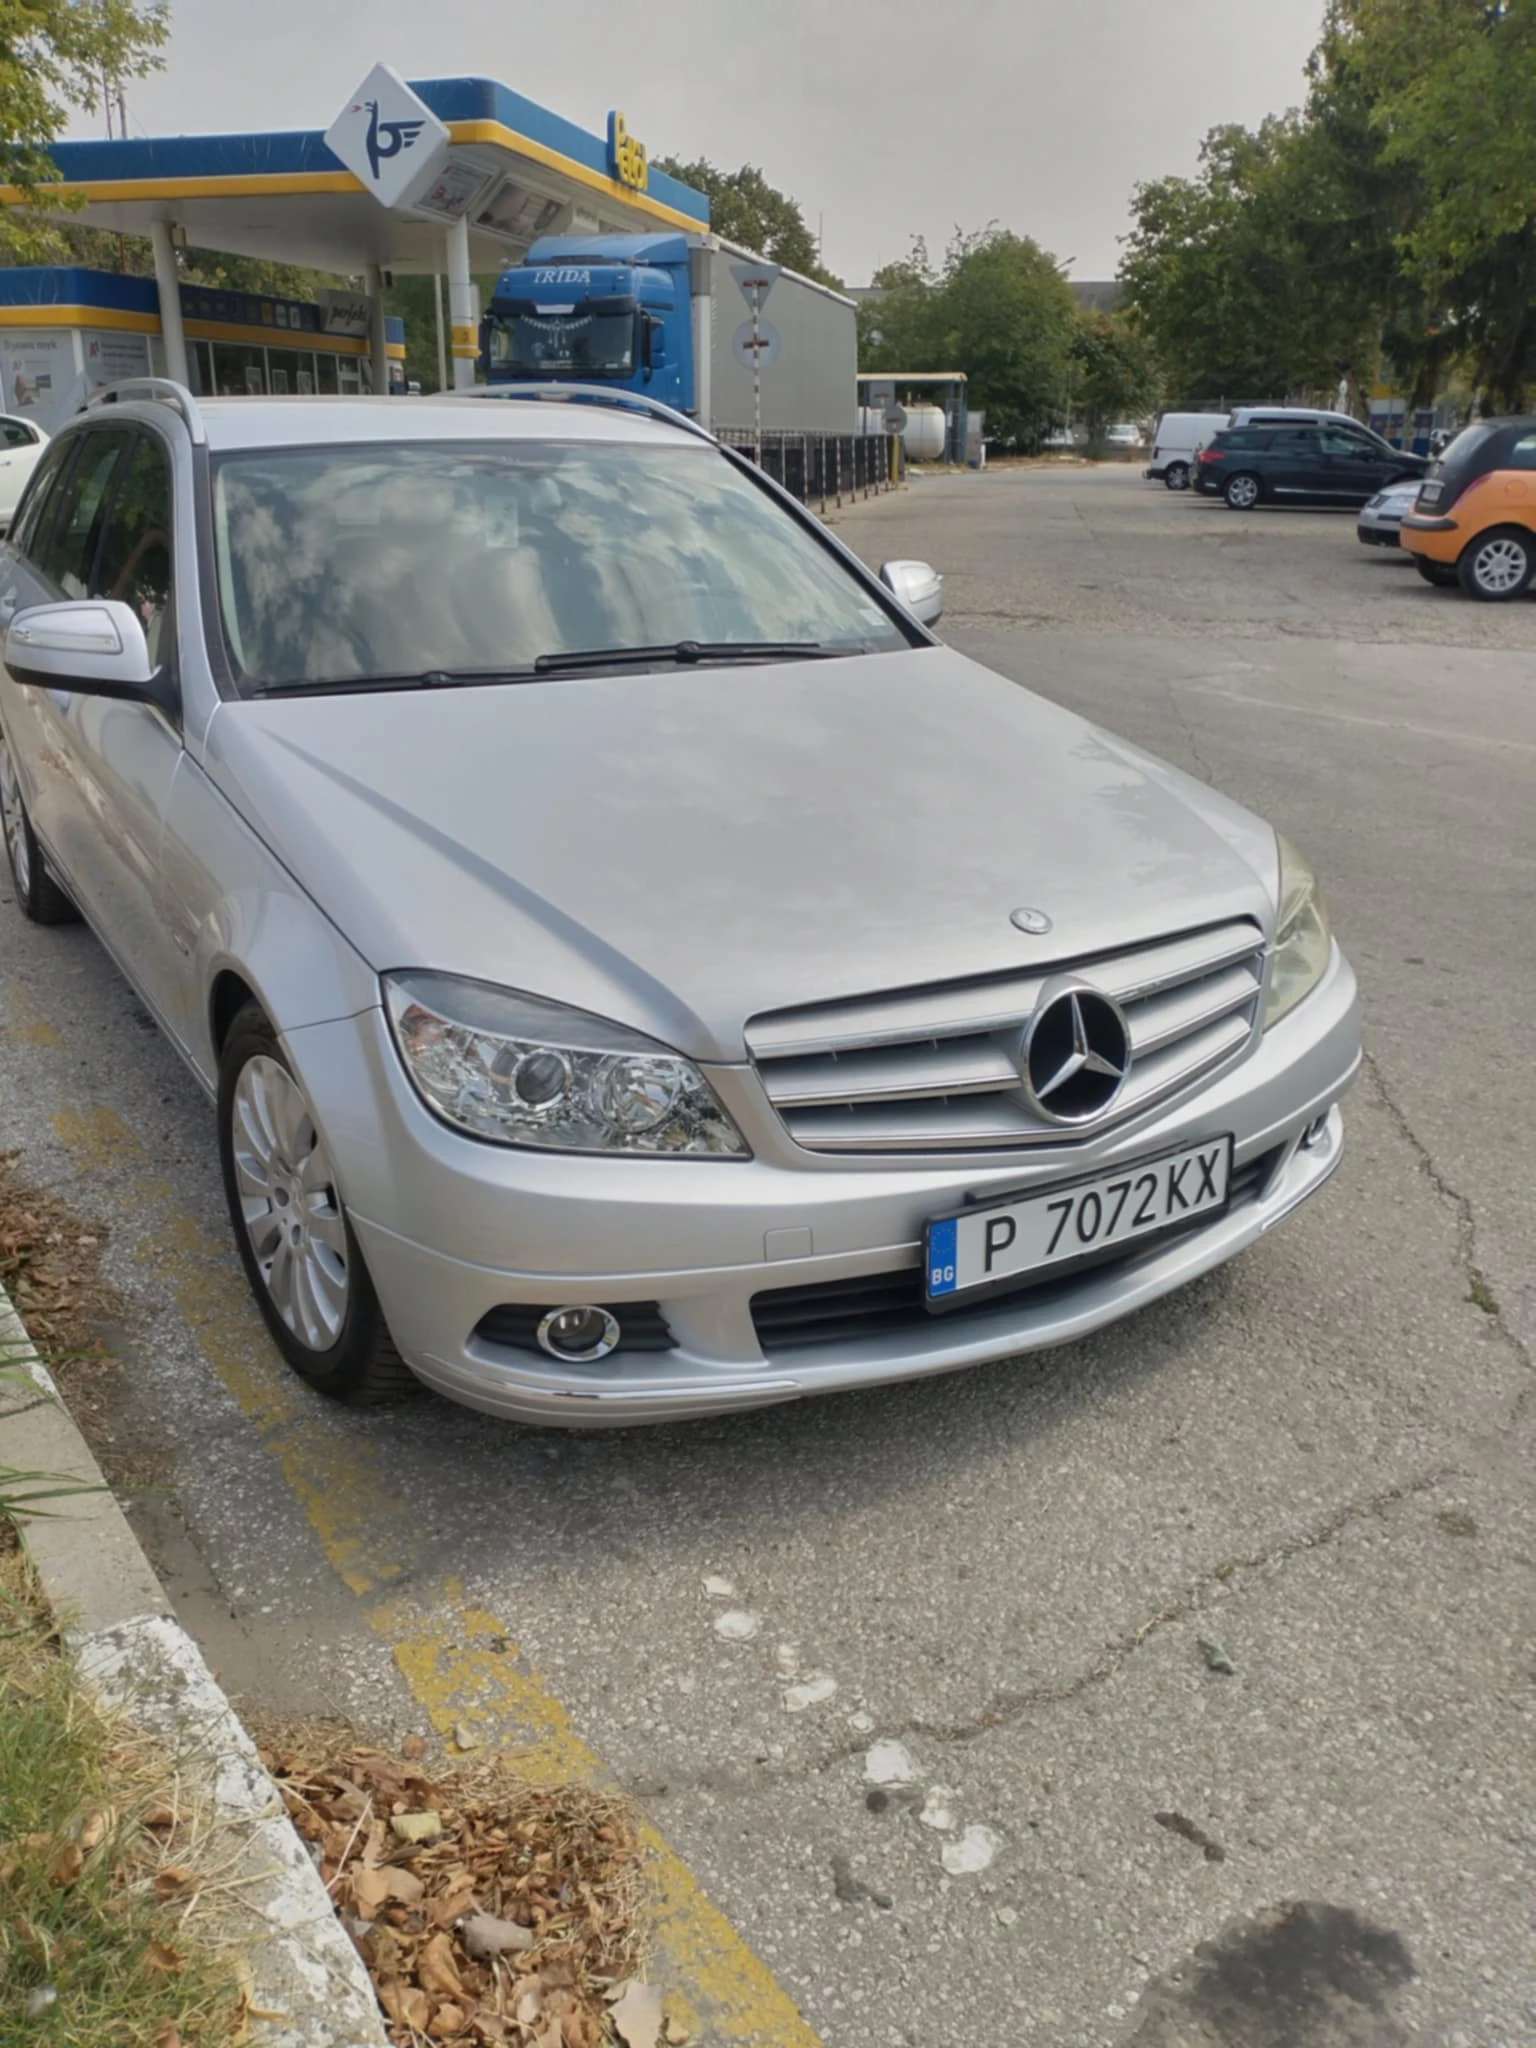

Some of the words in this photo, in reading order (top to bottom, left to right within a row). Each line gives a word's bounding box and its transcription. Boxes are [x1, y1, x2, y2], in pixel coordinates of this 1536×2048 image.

[533, 269, 591, 284] IRIDA
[985, 1216, 1017, 1272] P
[931, 1265, 955, 1286] BG
